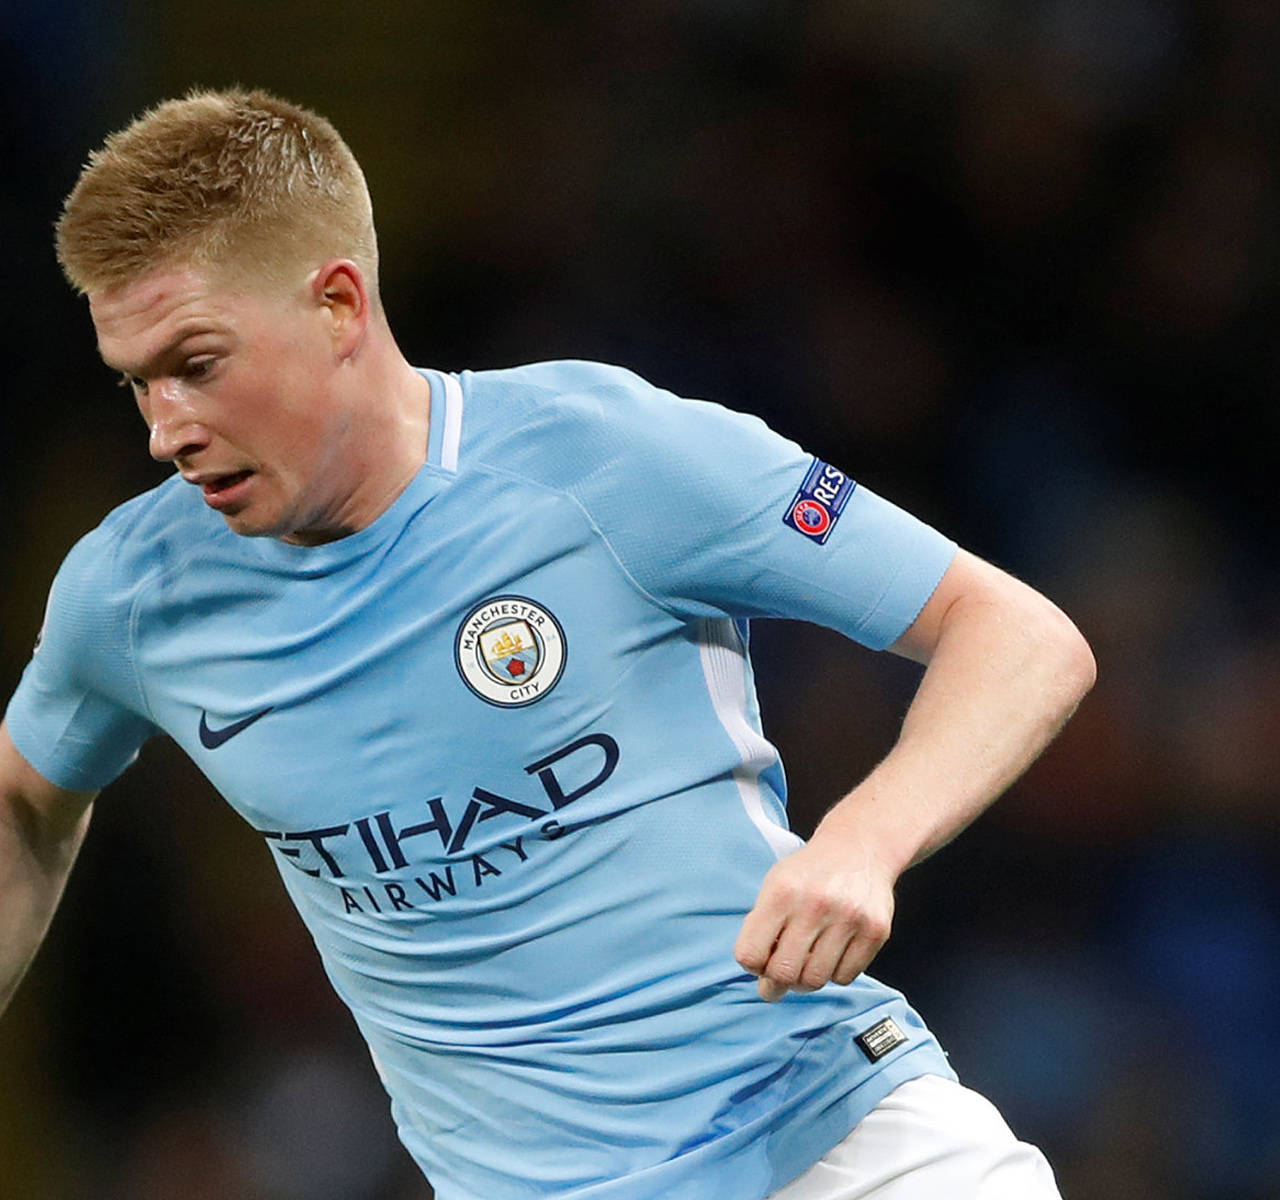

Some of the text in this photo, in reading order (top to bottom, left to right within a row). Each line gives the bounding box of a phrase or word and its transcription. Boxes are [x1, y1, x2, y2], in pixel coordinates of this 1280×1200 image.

[463, 604, 546, 651] MANCHESTER
[509, 682, 541, 700] CITY
[340, 819, 566, 914] AIRWAYS
